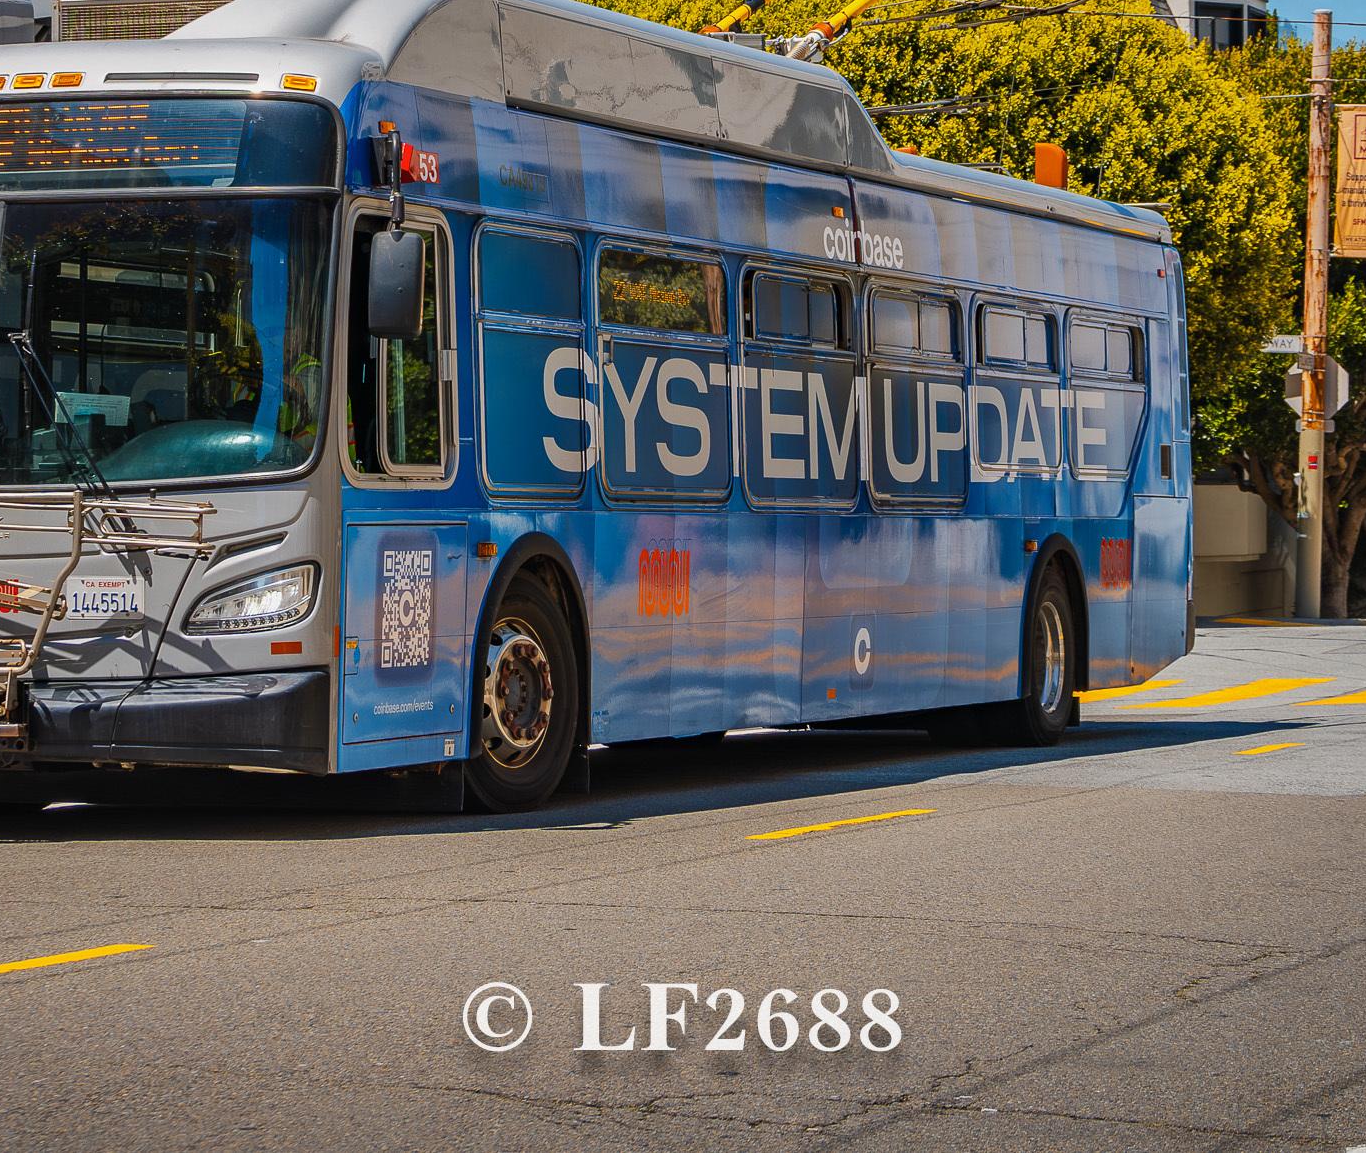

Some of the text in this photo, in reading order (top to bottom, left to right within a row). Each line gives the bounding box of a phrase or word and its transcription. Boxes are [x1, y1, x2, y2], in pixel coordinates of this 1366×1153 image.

[823, 217, 904, 269] coinbase
[542, 346, 1108, 484] SYSTEM UPDATE
[98, 581, 127, 589] EXEMPT
[72, 592, 139, 613] 1445514
[373, 698, 434, 716] coinbase.com/events
